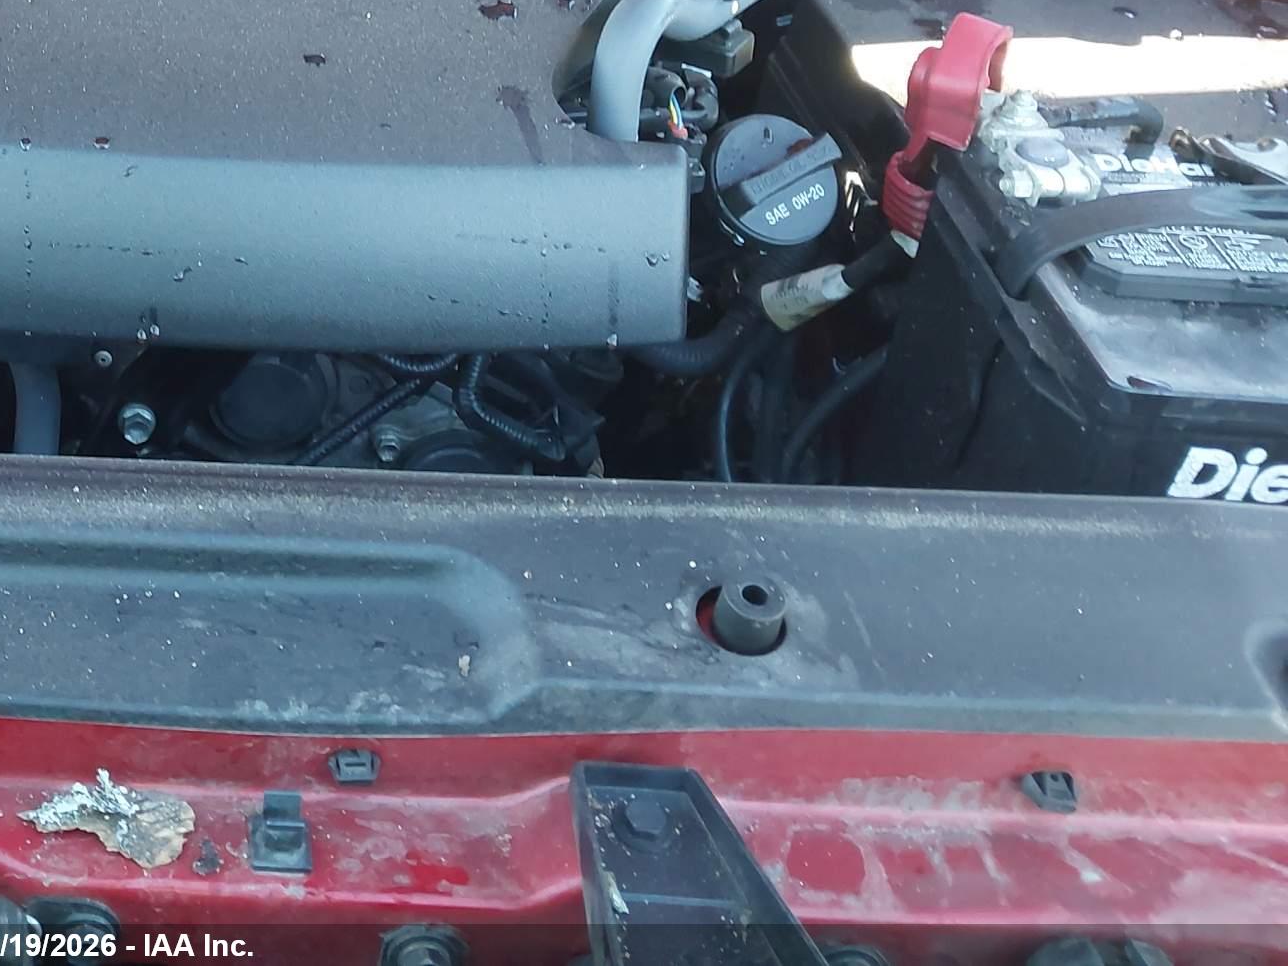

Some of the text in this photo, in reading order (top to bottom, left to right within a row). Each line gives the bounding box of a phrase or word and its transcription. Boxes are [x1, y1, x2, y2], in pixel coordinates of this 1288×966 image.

[1093, 153, 1215, 177] DieHar
[764, 183, 826, 226] SAE 0W-20
[1166, 446, 1288, 504] Die
